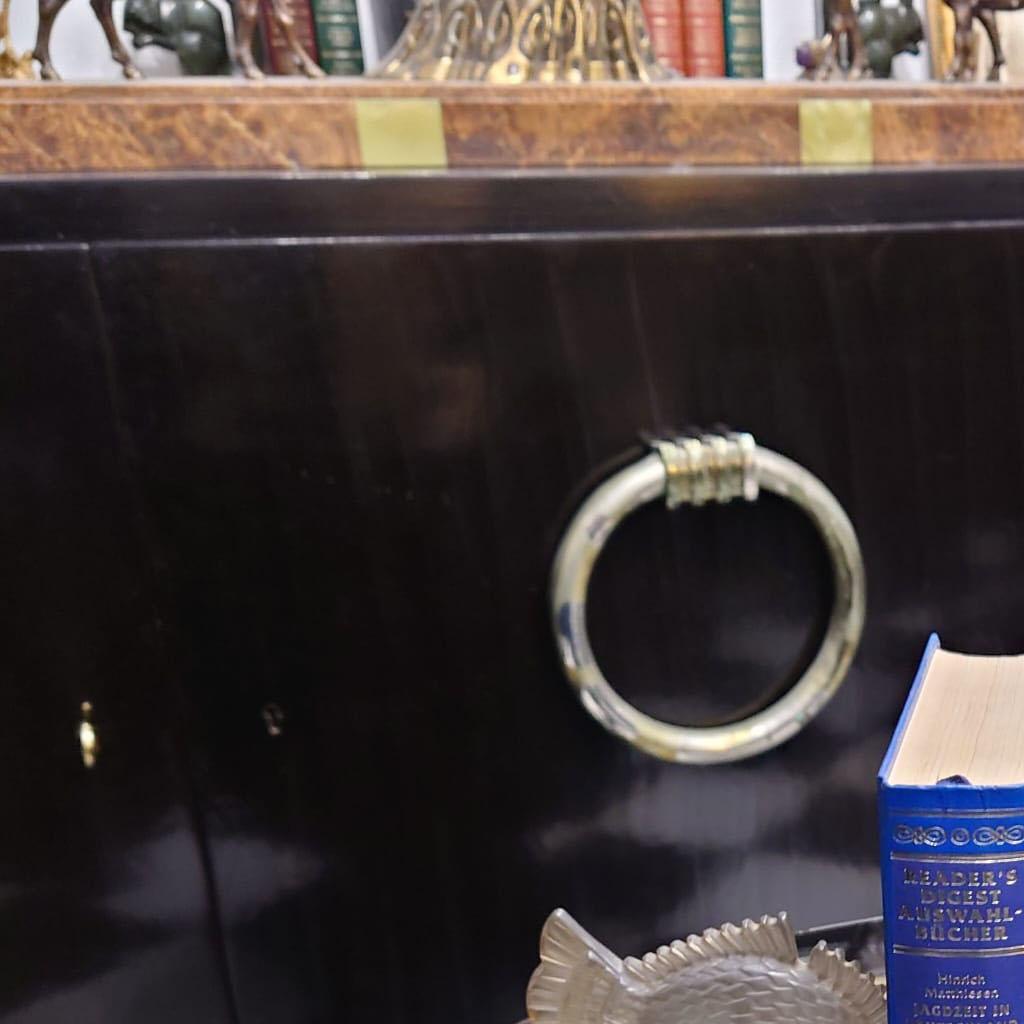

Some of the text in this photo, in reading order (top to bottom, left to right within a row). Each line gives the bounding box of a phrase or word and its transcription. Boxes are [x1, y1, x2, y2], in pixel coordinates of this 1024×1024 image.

[903, 867, 1018, 887] READER'S
[920, 888, 1002, 905] DIGEST
[898, 905, 1023, 923] AUSWAHL-
[937, 971, 986, 986] Hinrich
[913, 1002, 1011, 1017] JAGDZEIT IN
